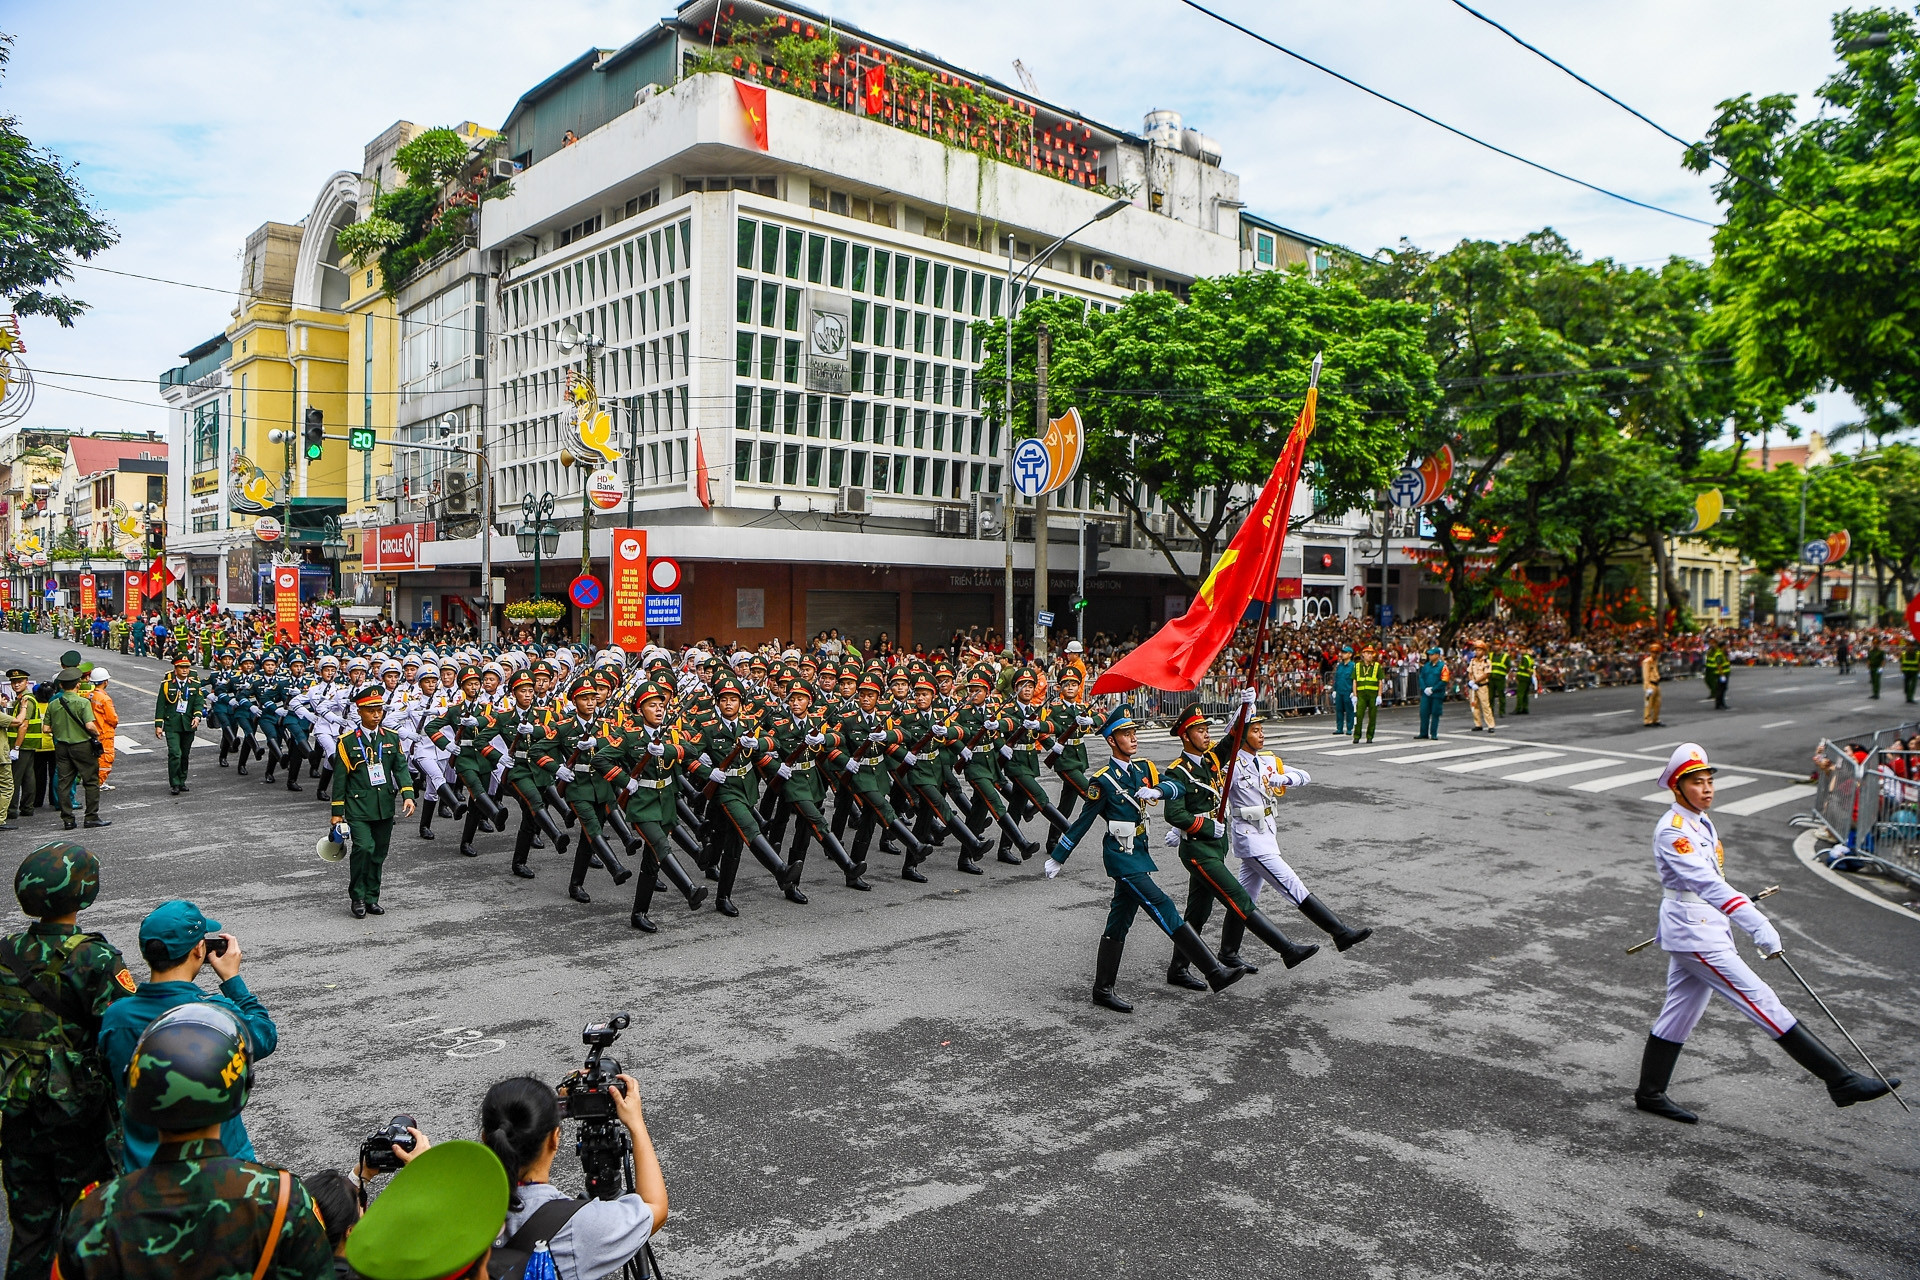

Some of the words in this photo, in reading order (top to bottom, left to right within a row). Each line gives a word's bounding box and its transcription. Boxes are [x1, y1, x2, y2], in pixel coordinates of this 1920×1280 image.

[352, 432, 372, 448] 20
[597, 482, 614, 490] Bank
[380, 538, 402, 554] CIRCLE
[950, 572, 972, 586] TRIỂN
[1014, 578, 1032, 589] HUẬT
[1050, 578, 1078, 589] PAINTIN
[1085, 578, 1122, 590] EXHIBITION
[648, 597, 660, 606] TUYẾN
[661, 597, 669, 606] PHỐ
[674, 598, 680, 607] BỘ
